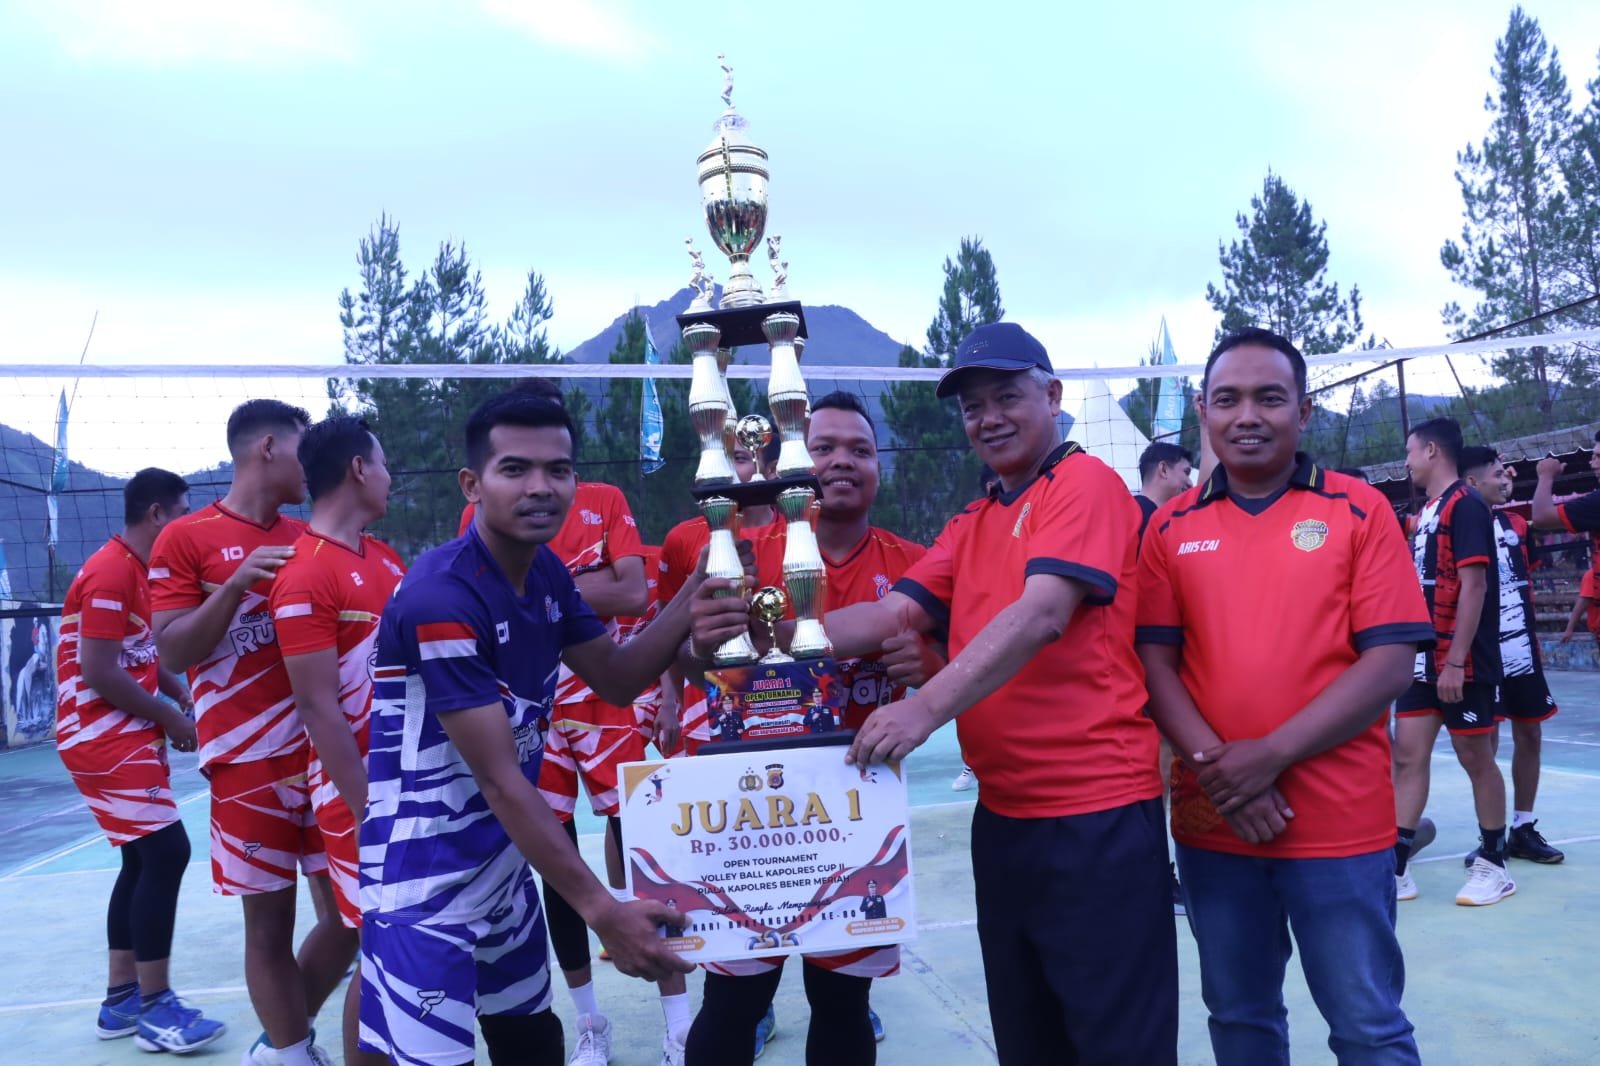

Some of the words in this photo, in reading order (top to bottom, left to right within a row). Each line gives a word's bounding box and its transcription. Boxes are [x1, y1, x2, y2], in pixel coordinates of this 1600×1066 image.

[221, 546, 244, 561] 10
[350, 571, 364, 586] 2
[753, 679, 784, 690] JUARA
[671, 792, 832, 836] JUARA
[846, 788, 863, 821] 1
[690, 839, 722, 856] Rp.
[728, 827, 853, 850] 30.000.000,-
[723, 859, 750, 868] OPEN
[752, 853, 818, 866] TOURNAMENT
[701, 872, 737, 882] VOLLEY
[739, 870, 763, 880] BALL
[765, 866, 815, 877] KAPOLRES
[817, 863, 837, 873] CUP
[697, 885, 726, 895] PIALA
[728, 881, 778, 893] KAPOLRES
[780, 878, 811, 889] BENER
[813, 875, 850, 885] MERIAH
[692, 920, 720, 932] HARI
